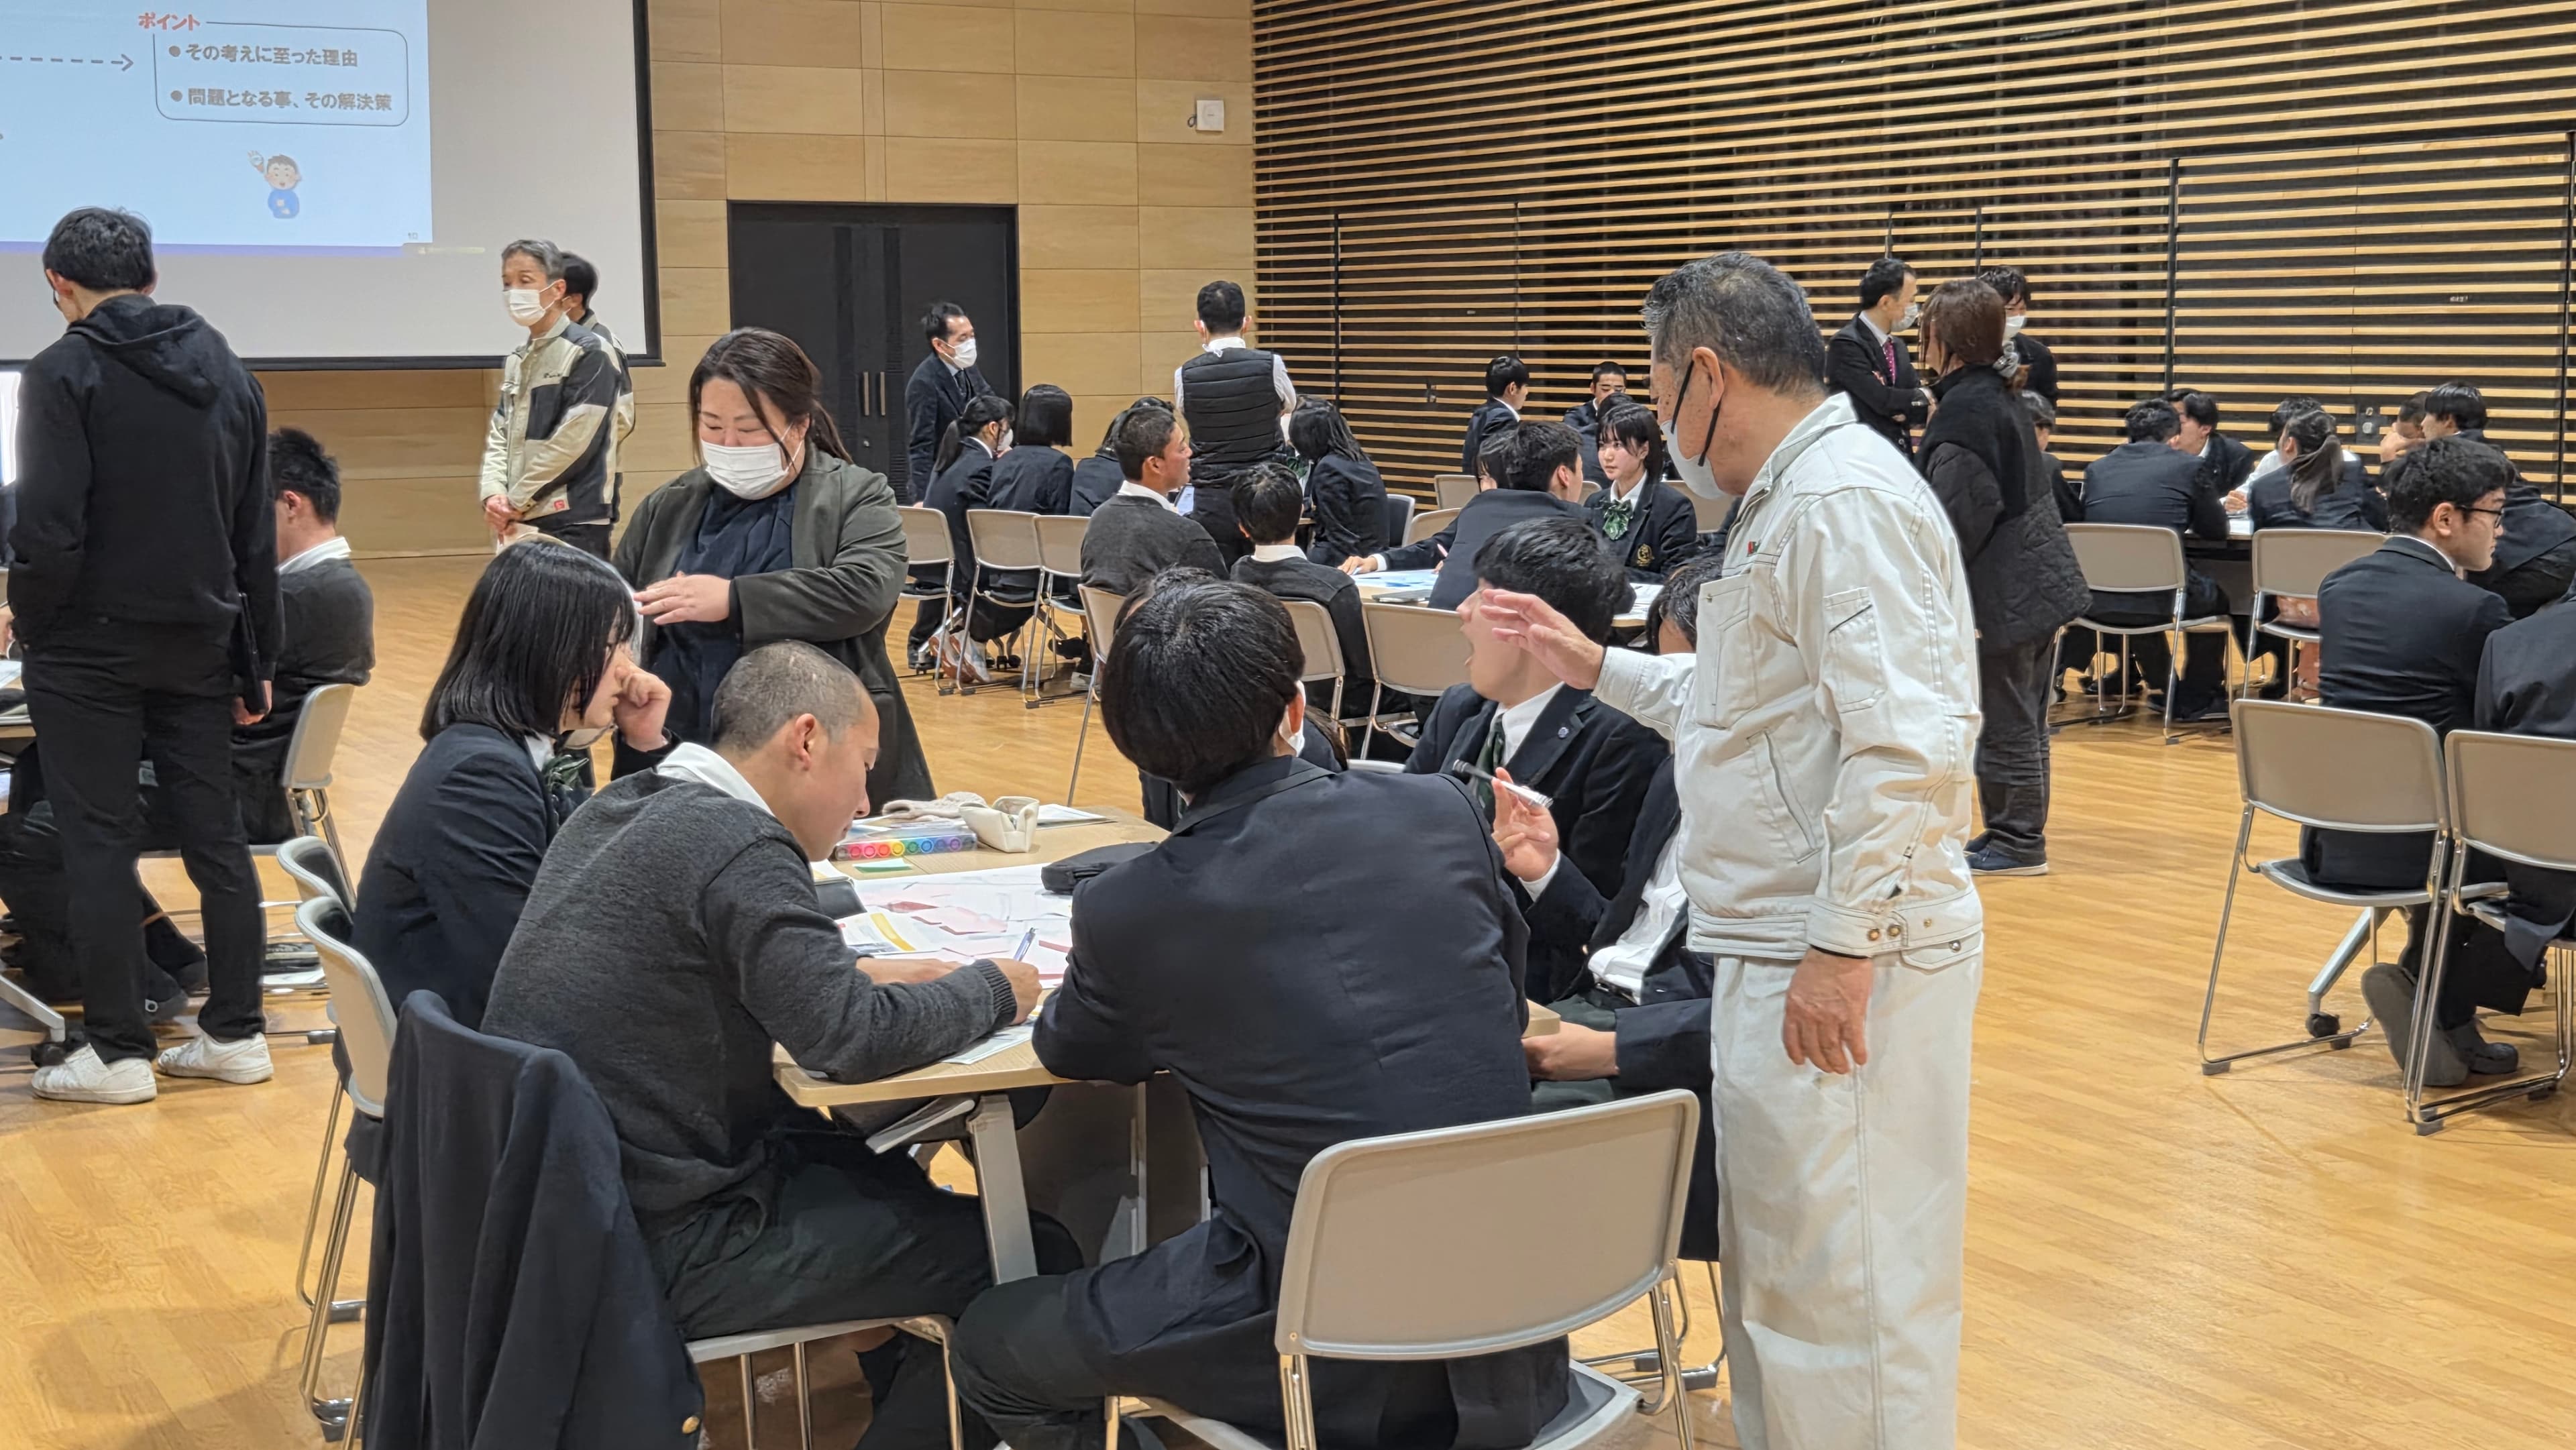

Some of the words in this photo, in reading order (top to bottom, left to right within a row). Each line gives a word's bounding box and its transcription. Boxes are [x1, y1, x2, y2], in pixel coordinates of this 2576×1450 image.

[138, 11, 201, 31] ポイント
[186, 44, 358, 67] その考えに至った理由
